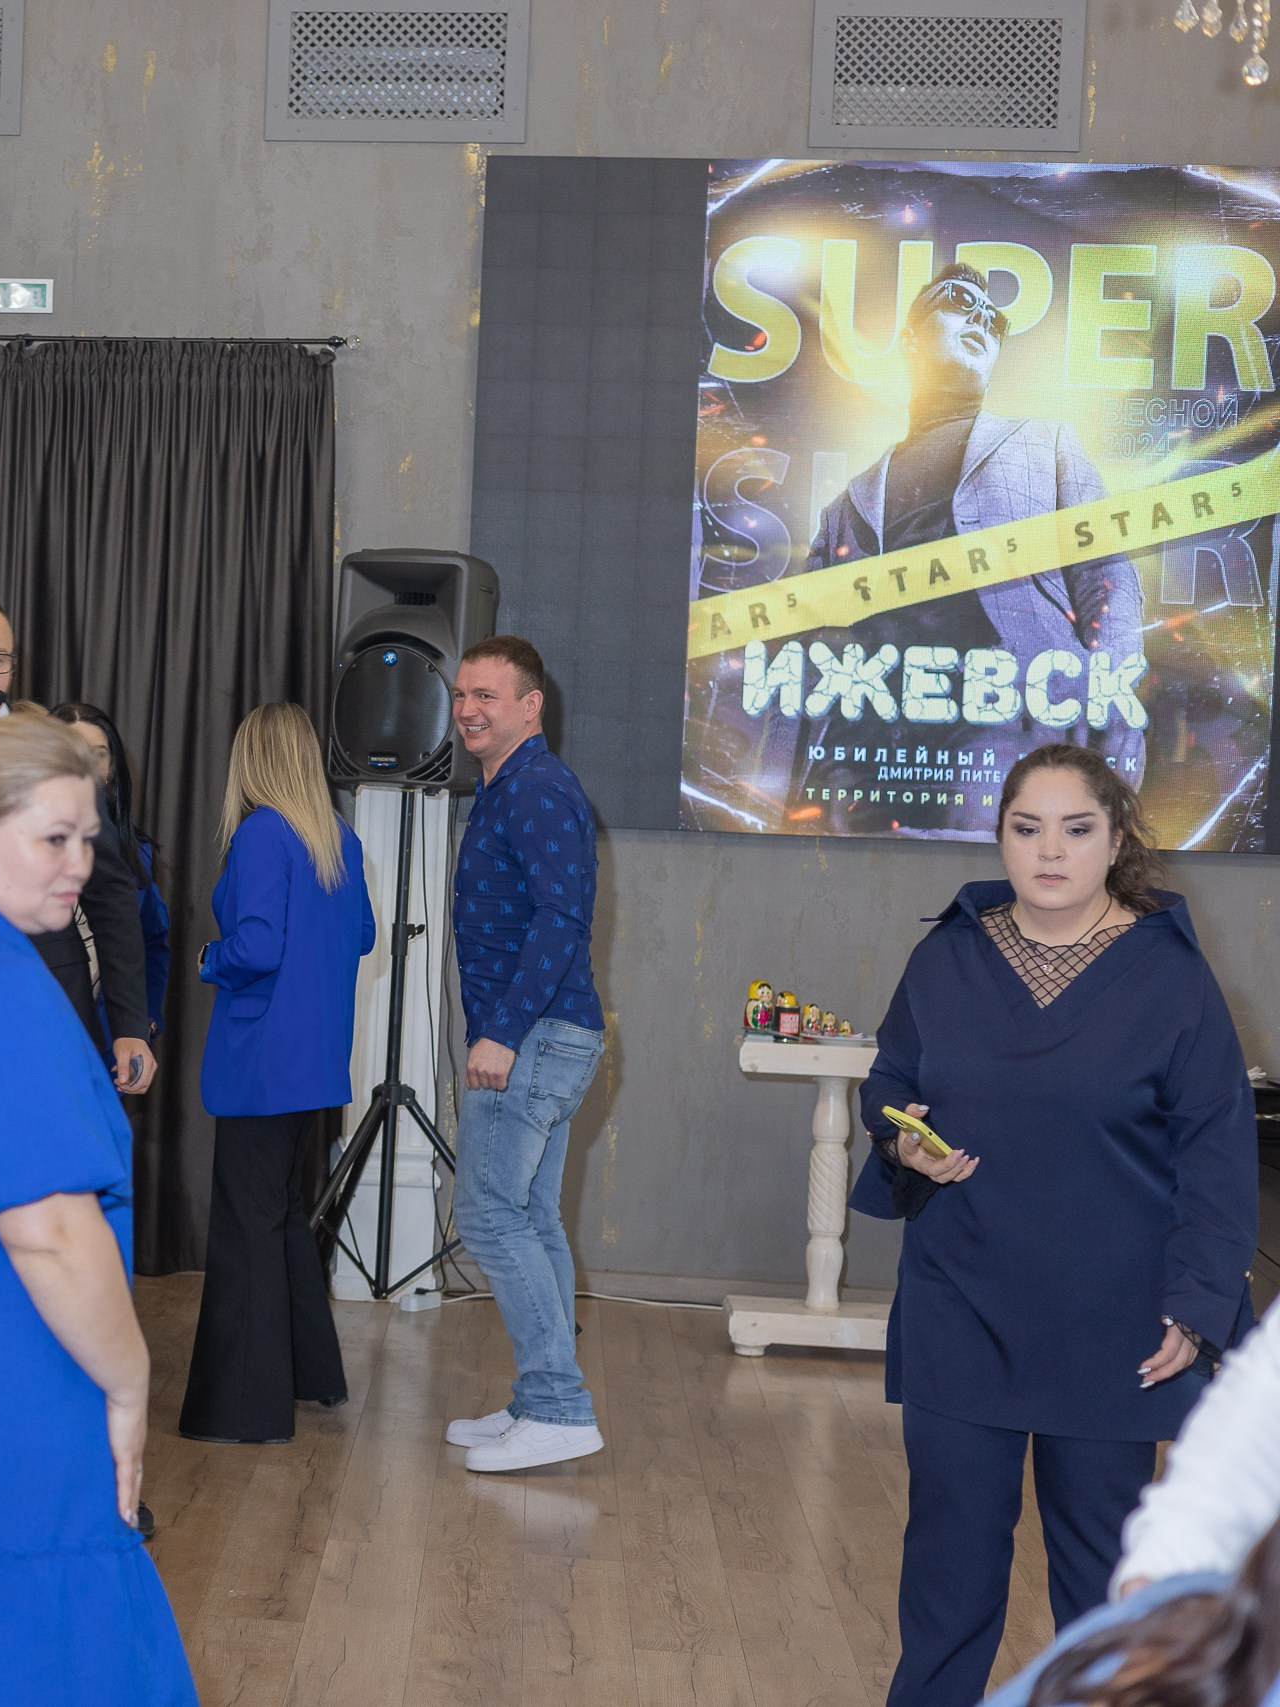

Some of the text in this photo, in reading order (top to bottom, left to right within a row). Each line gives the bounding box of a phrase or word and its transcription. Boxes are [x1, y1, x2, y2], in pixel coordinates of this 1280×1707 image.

[708, 235, 1277, 392] SUPER
[1100, 391, 1239, 429] ВЕСНОЙ
[1103, 432, 1171, 461] 2024
[741, 640, 1150, 731] ИЖЕВСК
[807, 744, 996, 768] ЮБИЛЕЙНЫЙ
[876, 765, 1007, 785] ДМИТРИЯ ПИТЕ
[805, 786, 965, 807] ТЕРРИТОРИЯ
